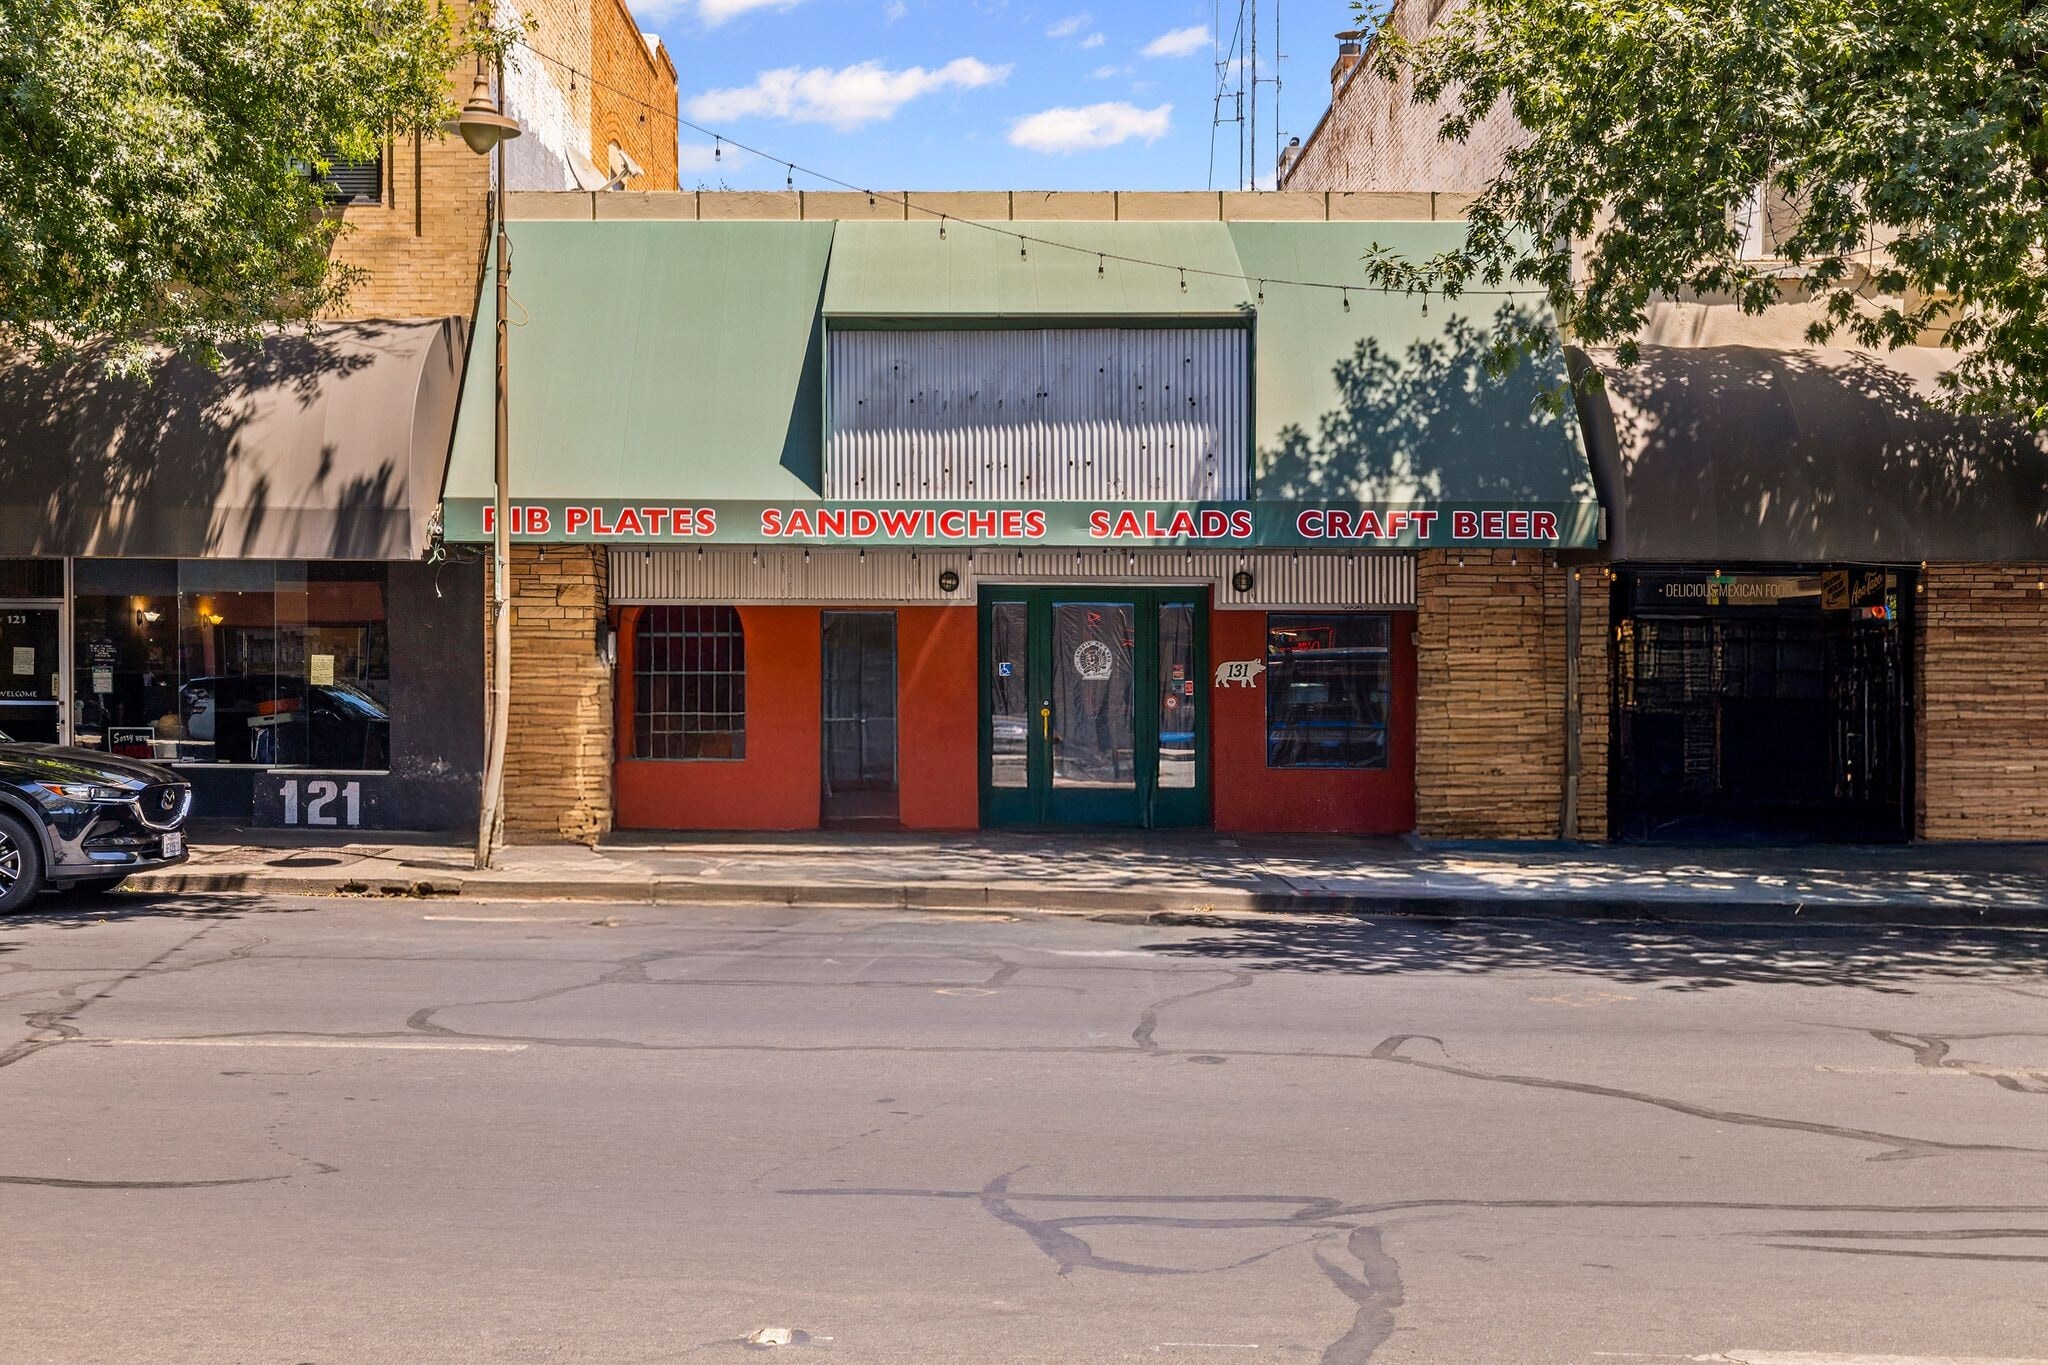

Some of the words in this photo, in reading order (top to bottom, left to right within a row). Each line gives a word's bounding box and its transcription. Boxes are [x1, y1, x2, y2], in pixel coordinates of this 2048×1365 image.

[565, 507, 717, 536] PLATES
[760, 508, 1046, 538] SANDWICHES
[1089, 509, 1253, 539] SALADS
[1296, 509, 1438, 539] CRAFT
[1452, 510, 1559, 539] BEER
[1666, 584, 1717, 597] DELICIOUS
[1719, 584, 1762, 597] MEXICAN
[1766, 584, 1792, 597] FOOD
[7, 615, 26, 624] 121
[1227, 663, 1249, 678] 131
[113, 732, 133, 743] Sorry
[280, 779, 360, 826] 121
